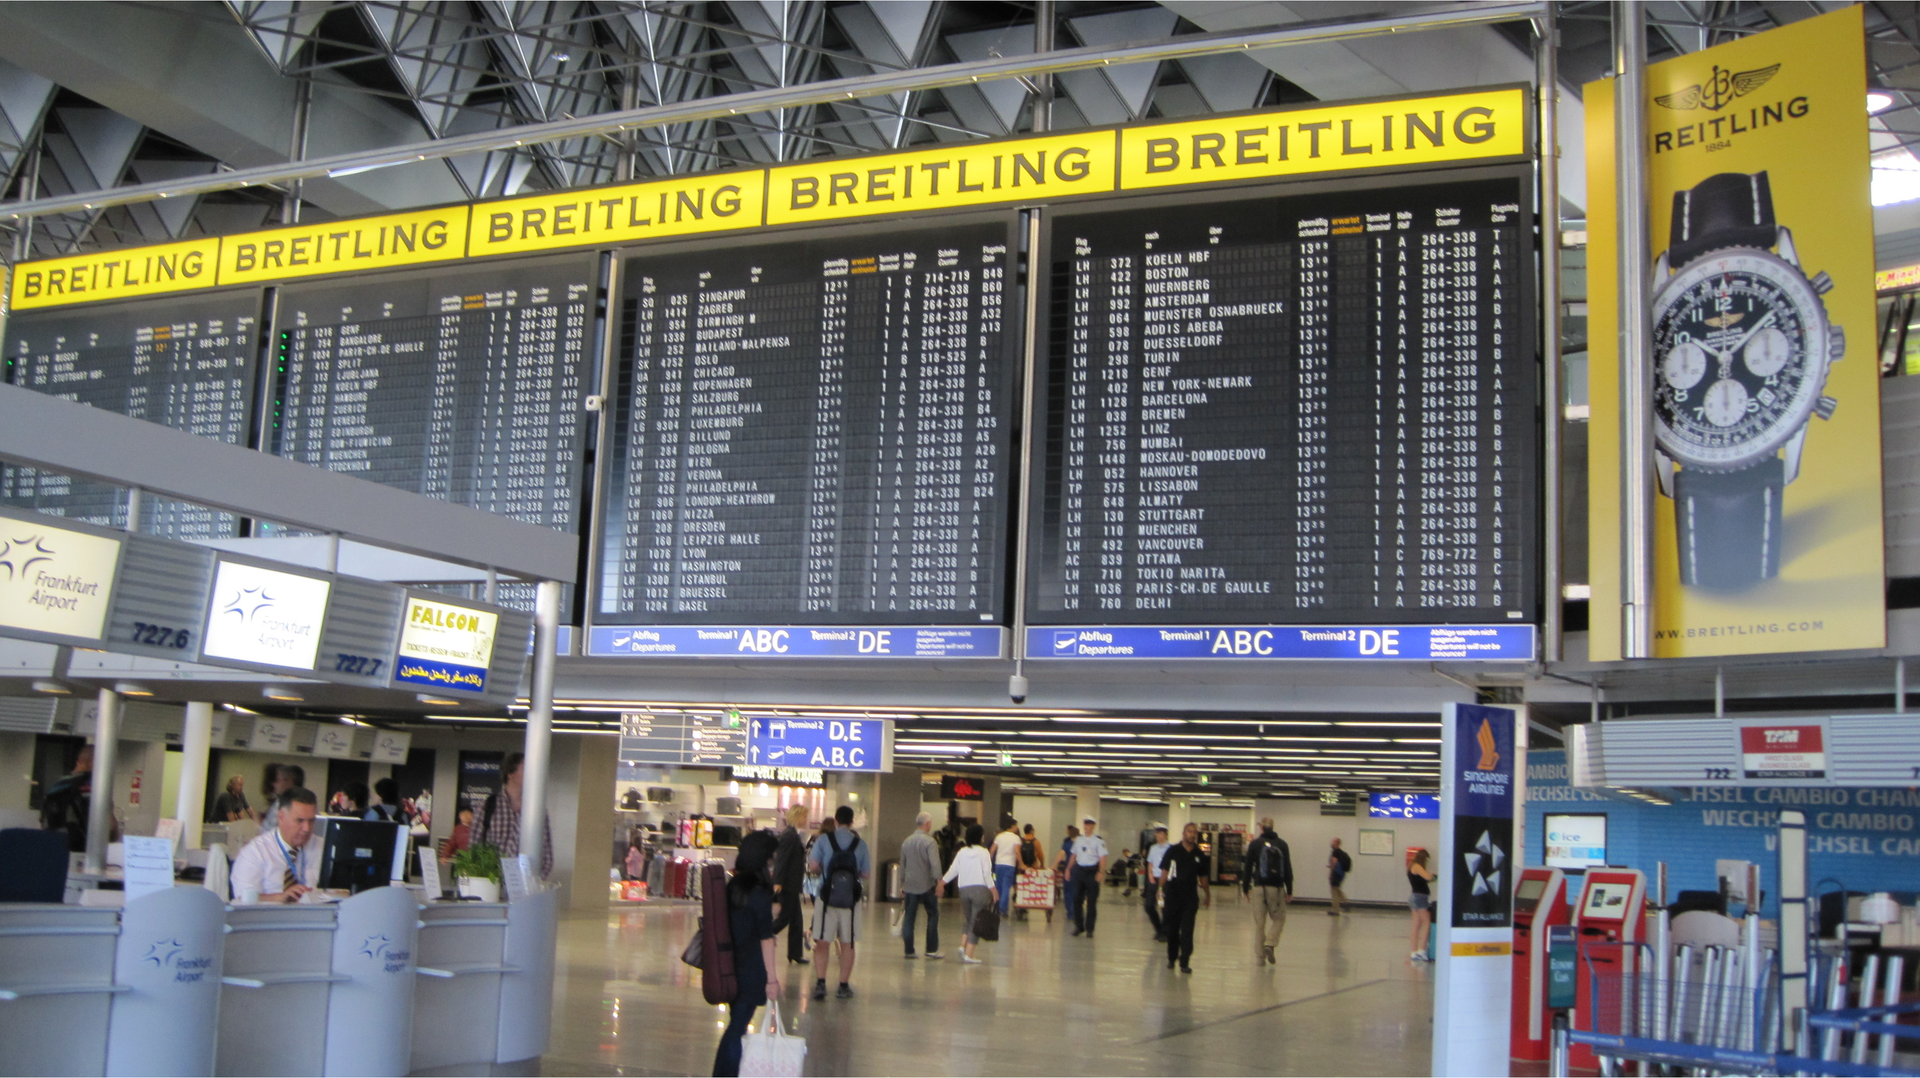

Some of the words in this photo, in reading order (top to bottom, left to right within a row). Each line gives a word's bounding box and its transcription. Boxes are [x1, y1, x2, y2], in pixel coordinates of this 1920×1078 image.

[1655, 96, 1809, 154] REITLING
[1146, 106, 1496, 174] BREITLING
[789, 147, 1092, 211] BREITLING
[487, 184, 743, 244] BREITLING
[236, 218, 448, 273] BREITLING
[1111, 258, 1131, 268] 372
[1146, 253, 1182, 266] KOELN
[1189, 251, 1209, 262] HBF
[1422, 231, 1476, 246] 264-338
[23, 250, 204, 299] BREITLING
[1111, 271, 1131, 283] 422
[1145, 267, 1189, 280] BOSTON
[699, 289, 745, 303] SINGAPUR
[925, 271, 969, 284] 714-719
[983, 268, 1002, 279] B48
[1145, 279, 1210, 293] NUERNBERG
[1145, 293, 1209, 307] AMSTERDAM
[1715, 297, 1732, 311] 12
[698, 303, 733, 316] ZAGREB
[1144, 308, 1202, 321] MUENSTER
[1209, 302, 1283, 317] OSNABRUECK
[696, 327, 743, 340] BUDAPEST
[1144, 323, 1180, 336] ADDIS
[1188, 321, 1224, 333] ABEBA
[695, 337, 790, 353] MAILAND-MALPENSA
[1144, 335, 1223, 350] DUESSELDORF
[695, 355, 718, 366] OSLO
[1144, 352, 1180, 364] TURIN
[694, 366, 735, 378] CHICAGO
[1143, 366, 1172, 378] GENF
[693, 378, 752, 391] KOPENHAGEN
[1143, 380, 1164, 392] NEW
[1172, 376, 1252, 391] YORK-NEWARK
[692, 391, 739, 404] SALZBURG
[1143, 393, 1208, 406] BARCELONA
[691, 403, 762, 417] PHILADELPHIA
[1142, 408, 1185, 420] BREMEN
[691, 416, 743, 430] LUXEMBURG
[1142, 423, 1170, 435] LINZ
[689, 430, 731, 442] BILLUND
[689, 443, 730, 455] BOLOGNA
[1141, 437, 1183, 449] MUMBAI
[1140, 448, 1266, 463] MOSKAU-DOMODEDOVO
[688, 457, 712, 468] WIEN
[687, 469, 722, 480] VERONA
[1140, 465, 1198, 477] HANNOVER
[686, 480, 757, 493] PHILADELPHIA
[1140, 480, 1198, 492] LISSABON
[686, 493, 775, 506] LONDON-HEATHROW
[1139, 495, 1183, 506] ALMATY
[684, 508, 714, 519] NIZZA
[1139, 508, 1204, 521] STUTTGART
[684, 521, 725, 533] DRESDEN
[1138, 523, 1197, 535] MUENCHEN
[683, 534, 725, 545] LEIPZIG
[730, 533, 760, 544] HALLE
[1138, 537, 1204, 550] VANCOUVER
[683, 548, 706, 558] LYON
[1138, 553, 1181, 565] OTTAWA
[682, 560, 741, 571] WASHINGTON
[681, 574, 727, 585] ISTANBUL
[1138, 568, 1173, 580] TOKIO
[1181, 568, 1225, 579] NARITA
[34, 570, 98, 597] Frankfurt
[1225, 582, 1270, 593] GAULLE
[680, 587, 727, 598] BRUESSEL
[29, 589, 78, 611] Airport
[679, 601, 708, 611] BASEL
[1136, 597, 1171, 609] DELHI
[411, 604, 479, 632] FALCON
[262, 616, 311, 636] Frankfurt
[1654, 620, 1824, 640] WW.BREITLING.COM
[134, 621, 189, 649] 727.6
[633, 630, 660, 641] Abflug
[697, 630, 732, 640] Terminal
[733, 630, 738, 639] 1
[738, 630, 789, 653] ABC
[810, 630, 848, 640] Terminal
[849, 631, 855, 640] 2
[858, 631, 891, 653] DE
[1079, 631, 1112, 643] Abflug
[632, 642, 676, 652] Departures
[1159, 630, 1203, 641] Terminal
[1205, 631, 1209, 640] 1
[1212, 630, 1273, 655] ABC
[1300, 631, 1346, 641] Terminal
[1348, 631, 1356, 641] 2
[1360, 630, 1399, 654] DE
[1079, 644, 1133, 656] Departures
[336, 654, 382, 676] 727.7
[787, 720, 816, 730] Terminal
[818, 721, 824, 730] 2
[829, 721, 862, 743] D,E
[785, 745, 806, 755] Gates
[811, 747, 864, 767] A,B,C
[1464, 771, 1509, 784] SINGAPORE
[1527, 764, 1567, 780] AMBIO
[1706, 768, 1731, 779] 722
[1469, 783, 1505, 795] AIRLINES
[1692, 787, 1748, 802] HSEL
[1754, 788, 1849, 805] CAMBIO
[1817, 812, 1913, 831] CAMBIO
